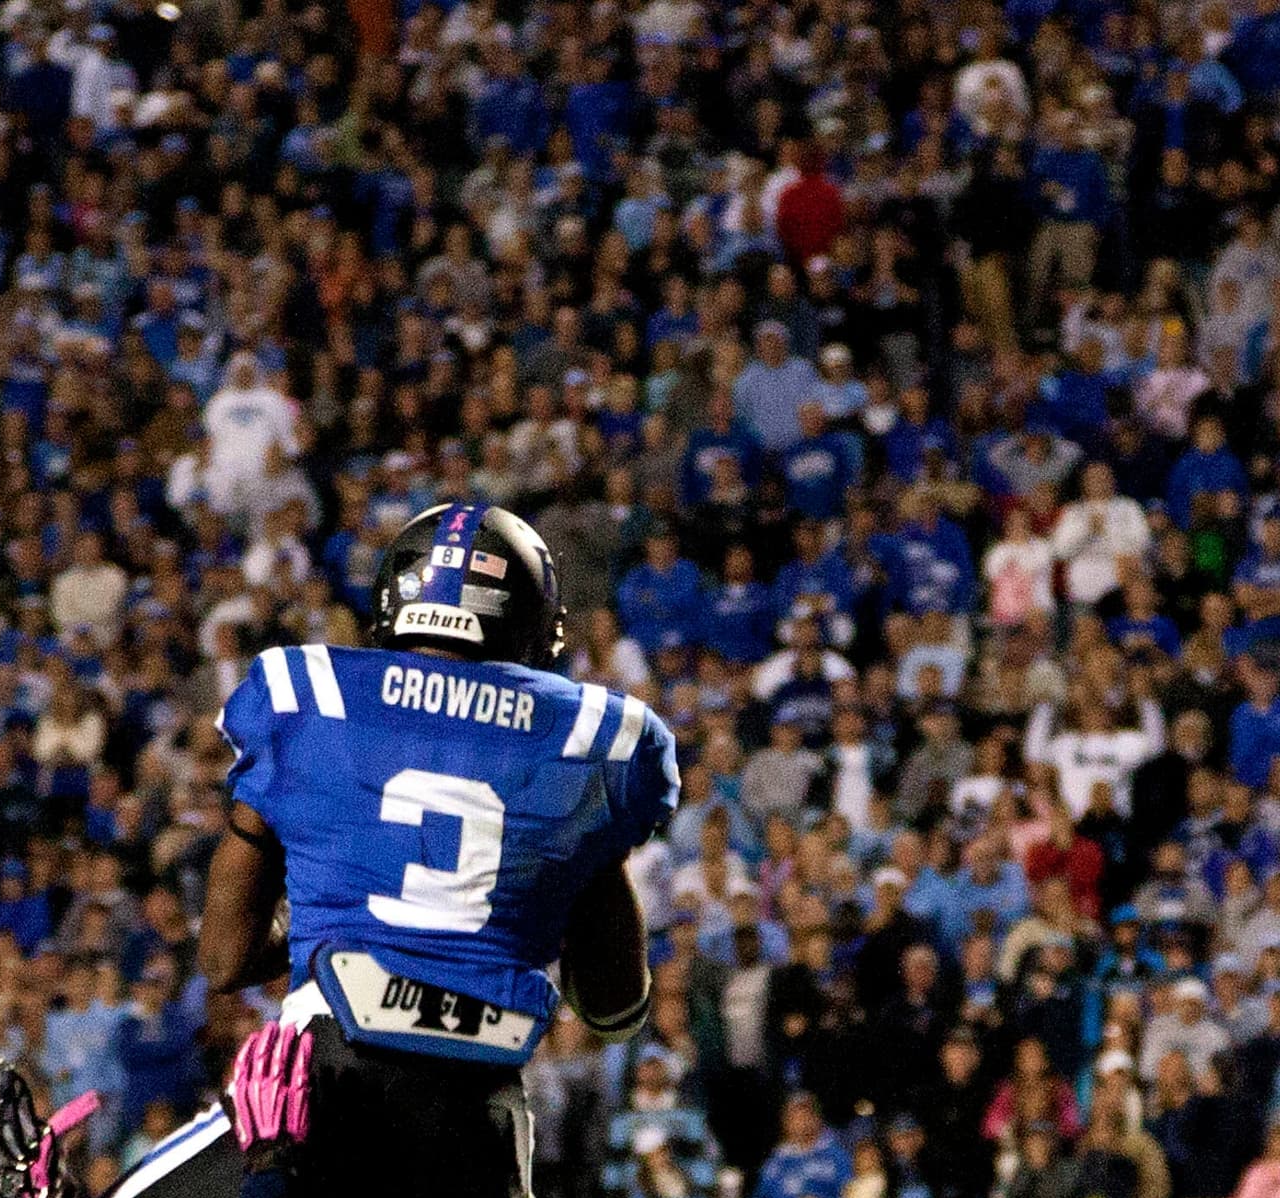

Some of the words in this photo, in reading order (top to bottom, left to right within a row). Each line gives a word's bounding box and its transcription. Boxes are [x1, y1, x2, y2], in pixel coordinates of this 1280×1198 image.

[405, 611, 474, 631] schutt
[382, 665, 535, 732] CROWDER
[368, 769, 506, 932] 3
